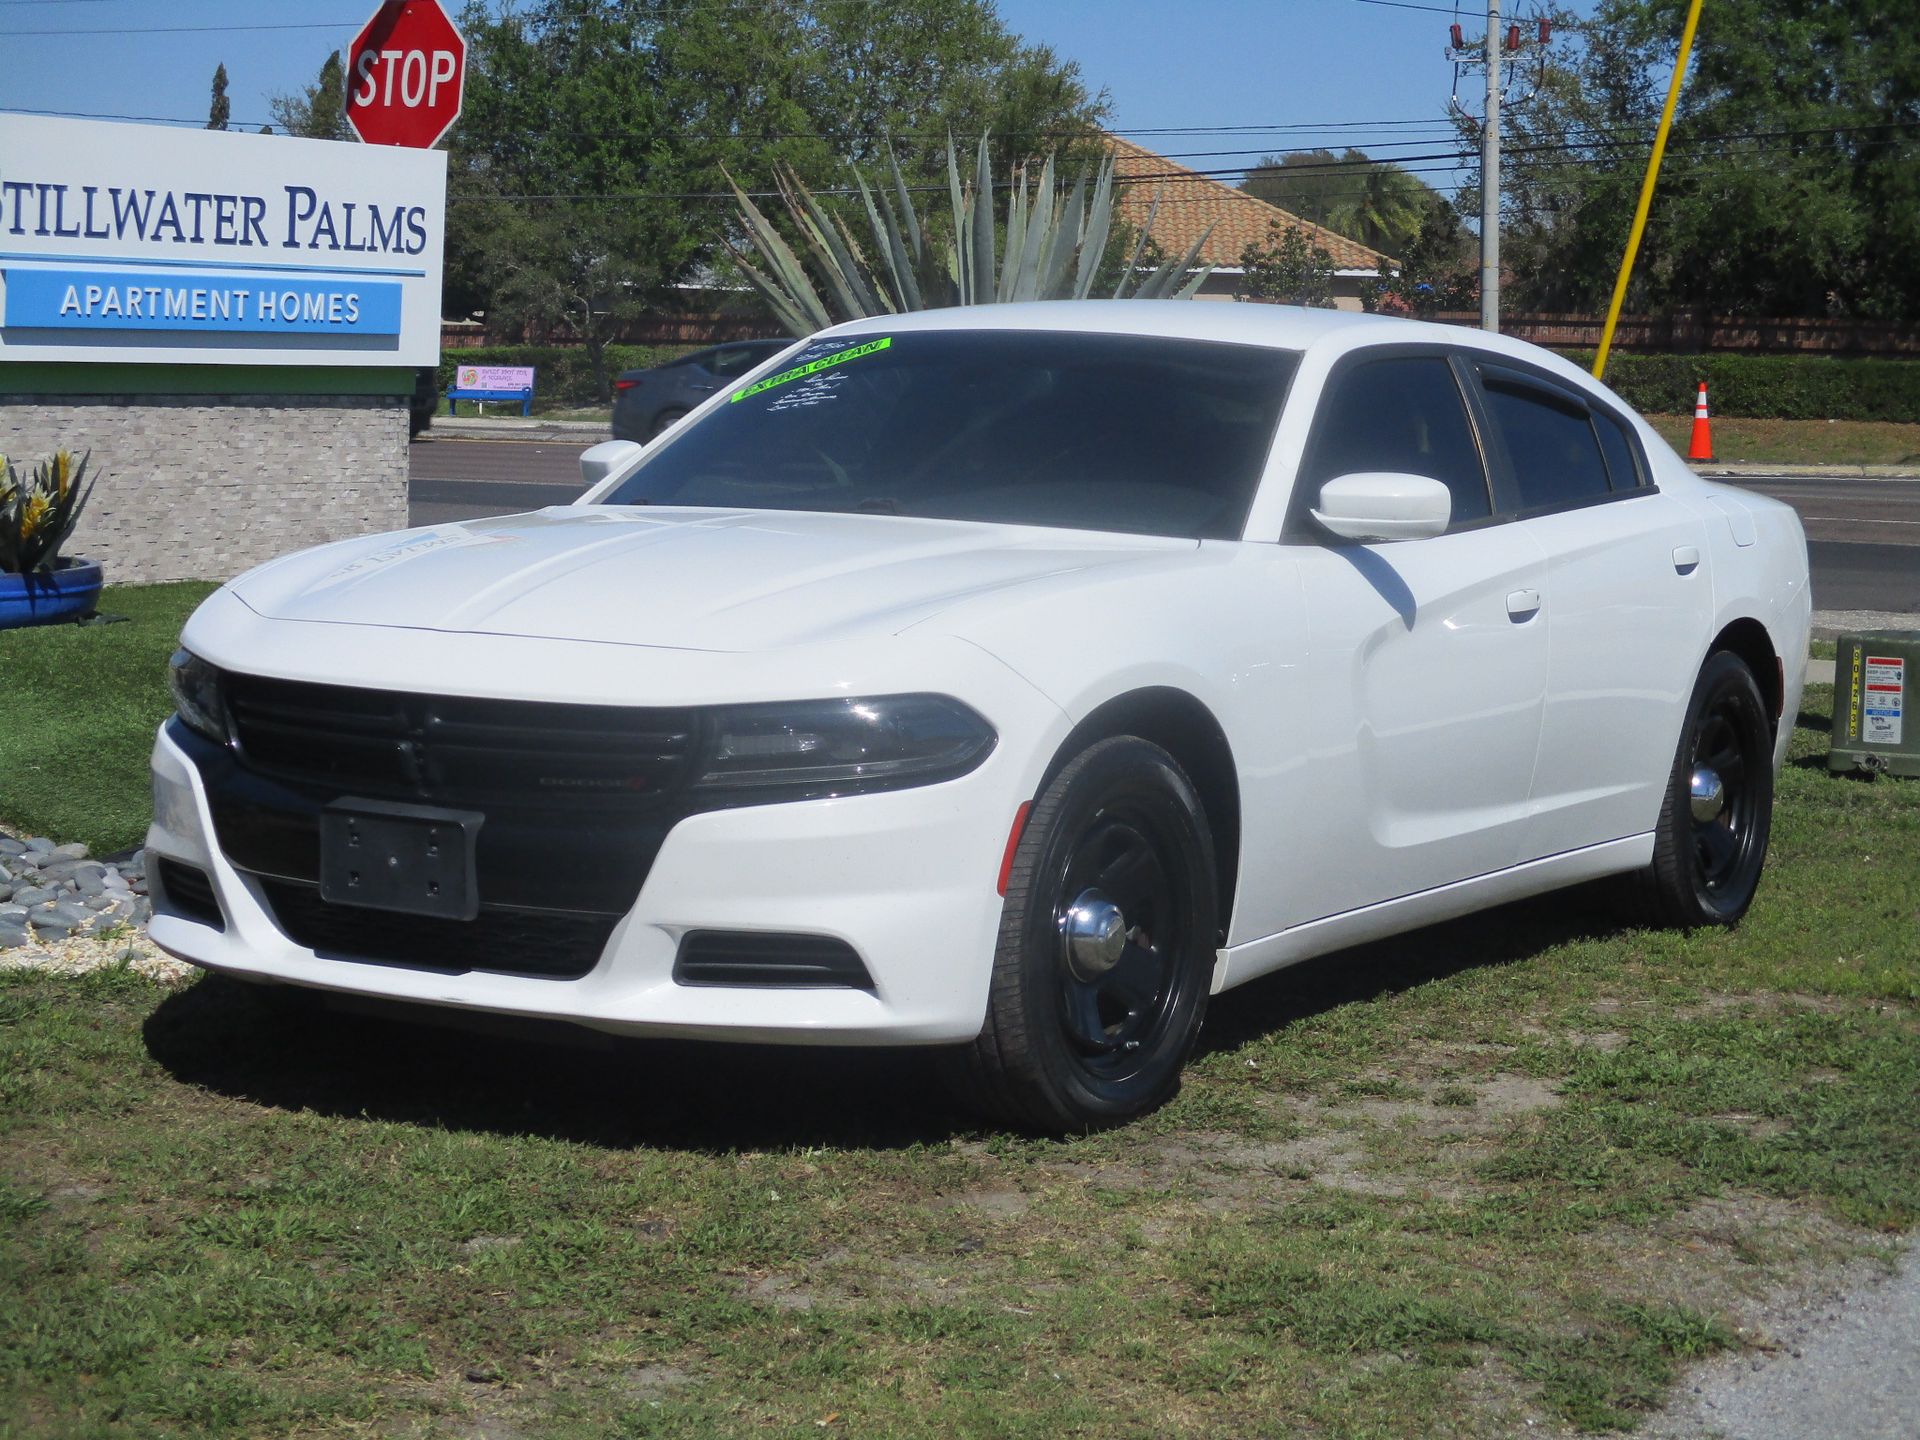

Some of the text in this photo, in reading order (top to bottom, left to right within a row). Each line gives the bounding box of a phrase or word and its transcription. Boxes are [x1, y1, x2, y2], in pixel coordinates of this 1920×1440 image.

[354, 49, 456, 108] STOP
[0, 178, 427, 255] TILLWATER PALMS
[60, 284, 360, 323] APARTMENT HOMES
[742, 366, 807, 397] EXTRA
[813, 340, 883, 370] CLEAN
